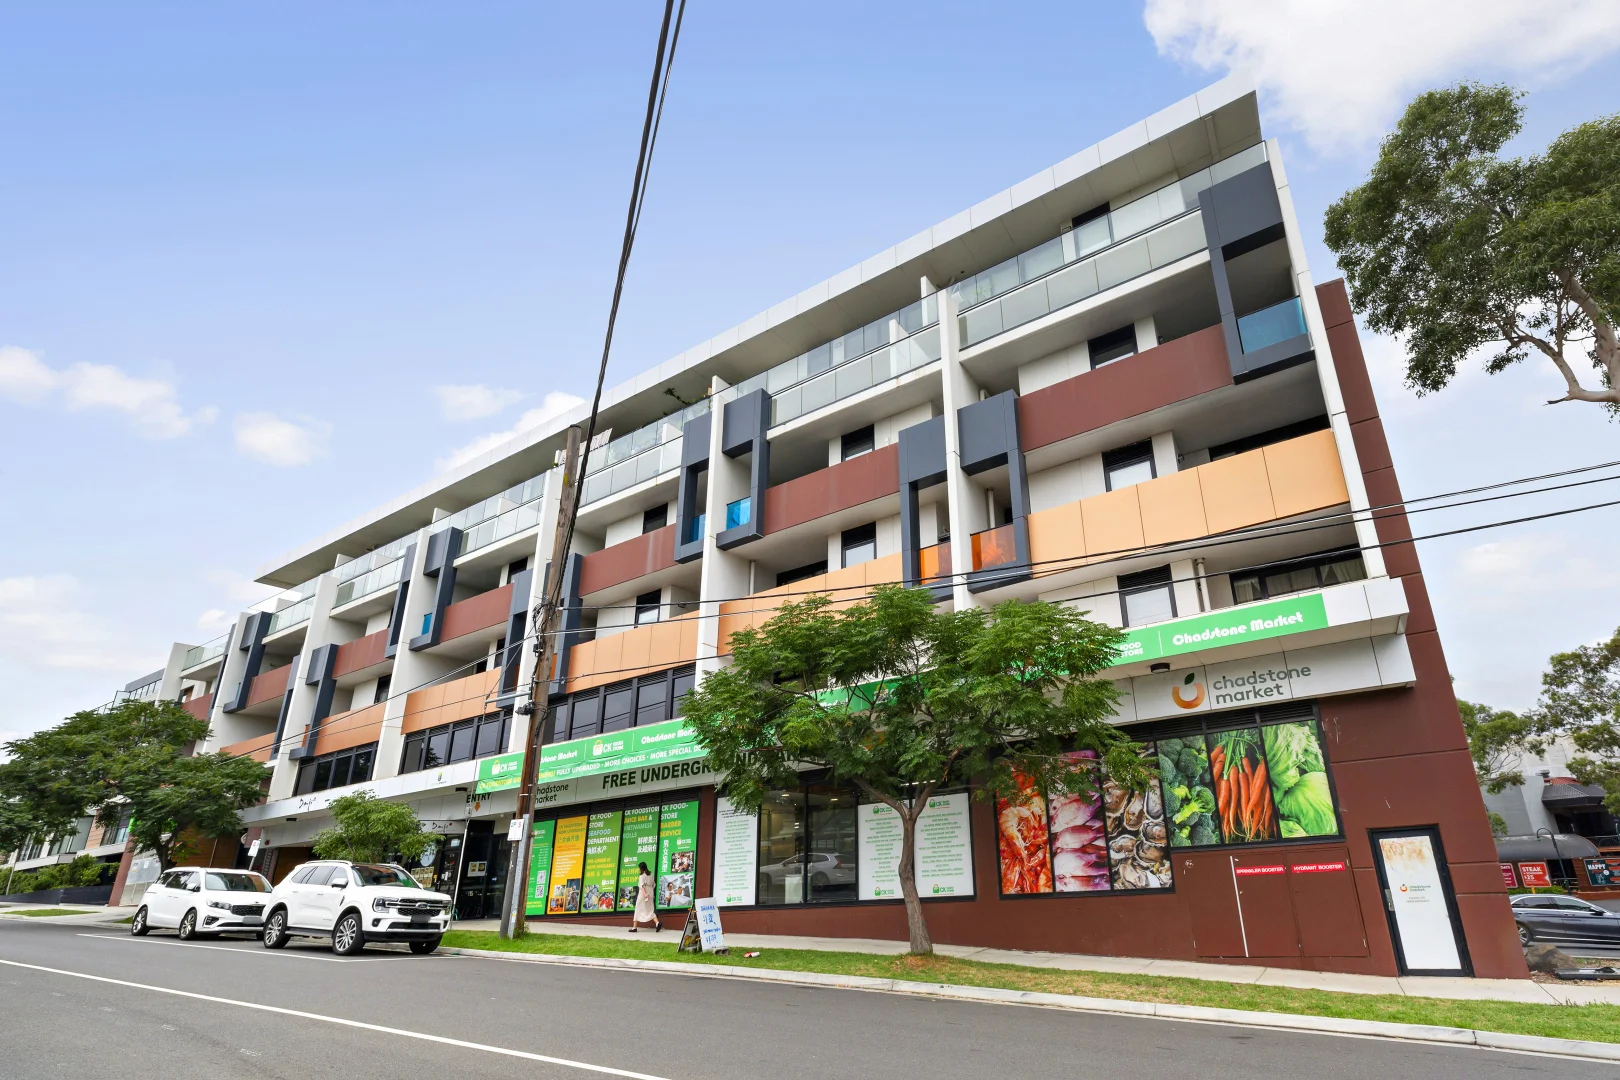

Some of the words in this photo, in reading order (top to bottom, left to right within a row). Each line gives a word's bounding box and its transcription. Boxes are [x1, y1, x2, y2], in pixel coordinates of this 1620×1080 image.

[1172, 624, 1248, 646] Chadstone
[1249, 611, 1304, 632] Market
[1213, 666, 1312, 690] chadstone
[1215, 683, 1284, 705] market
[641, 732, 676, 744] Chadstone
[556, 768, 571, 776] FULLY
[572, 763, 600, 773] UPGRADED
[604, 759, 620, 767] MORE
[622, 754, 646, 764] CHOICES
[650, 750, 667, 760] MORE
[668, 746, 692, 757] SPECIAL
[602, 770, 637, 789] FREE
[536, 784, 569, 795] hadstone
[466, 792, 492, 804] ENTRY
[660, 812, 678, 820] STORE
[660, 820, 682, 828] BARBER
[588, 828, 612, 836] SEAFOOD
[660, 829, 682, 838] SERVICE
[588, 836, 620, 844] DEPARTMENT
